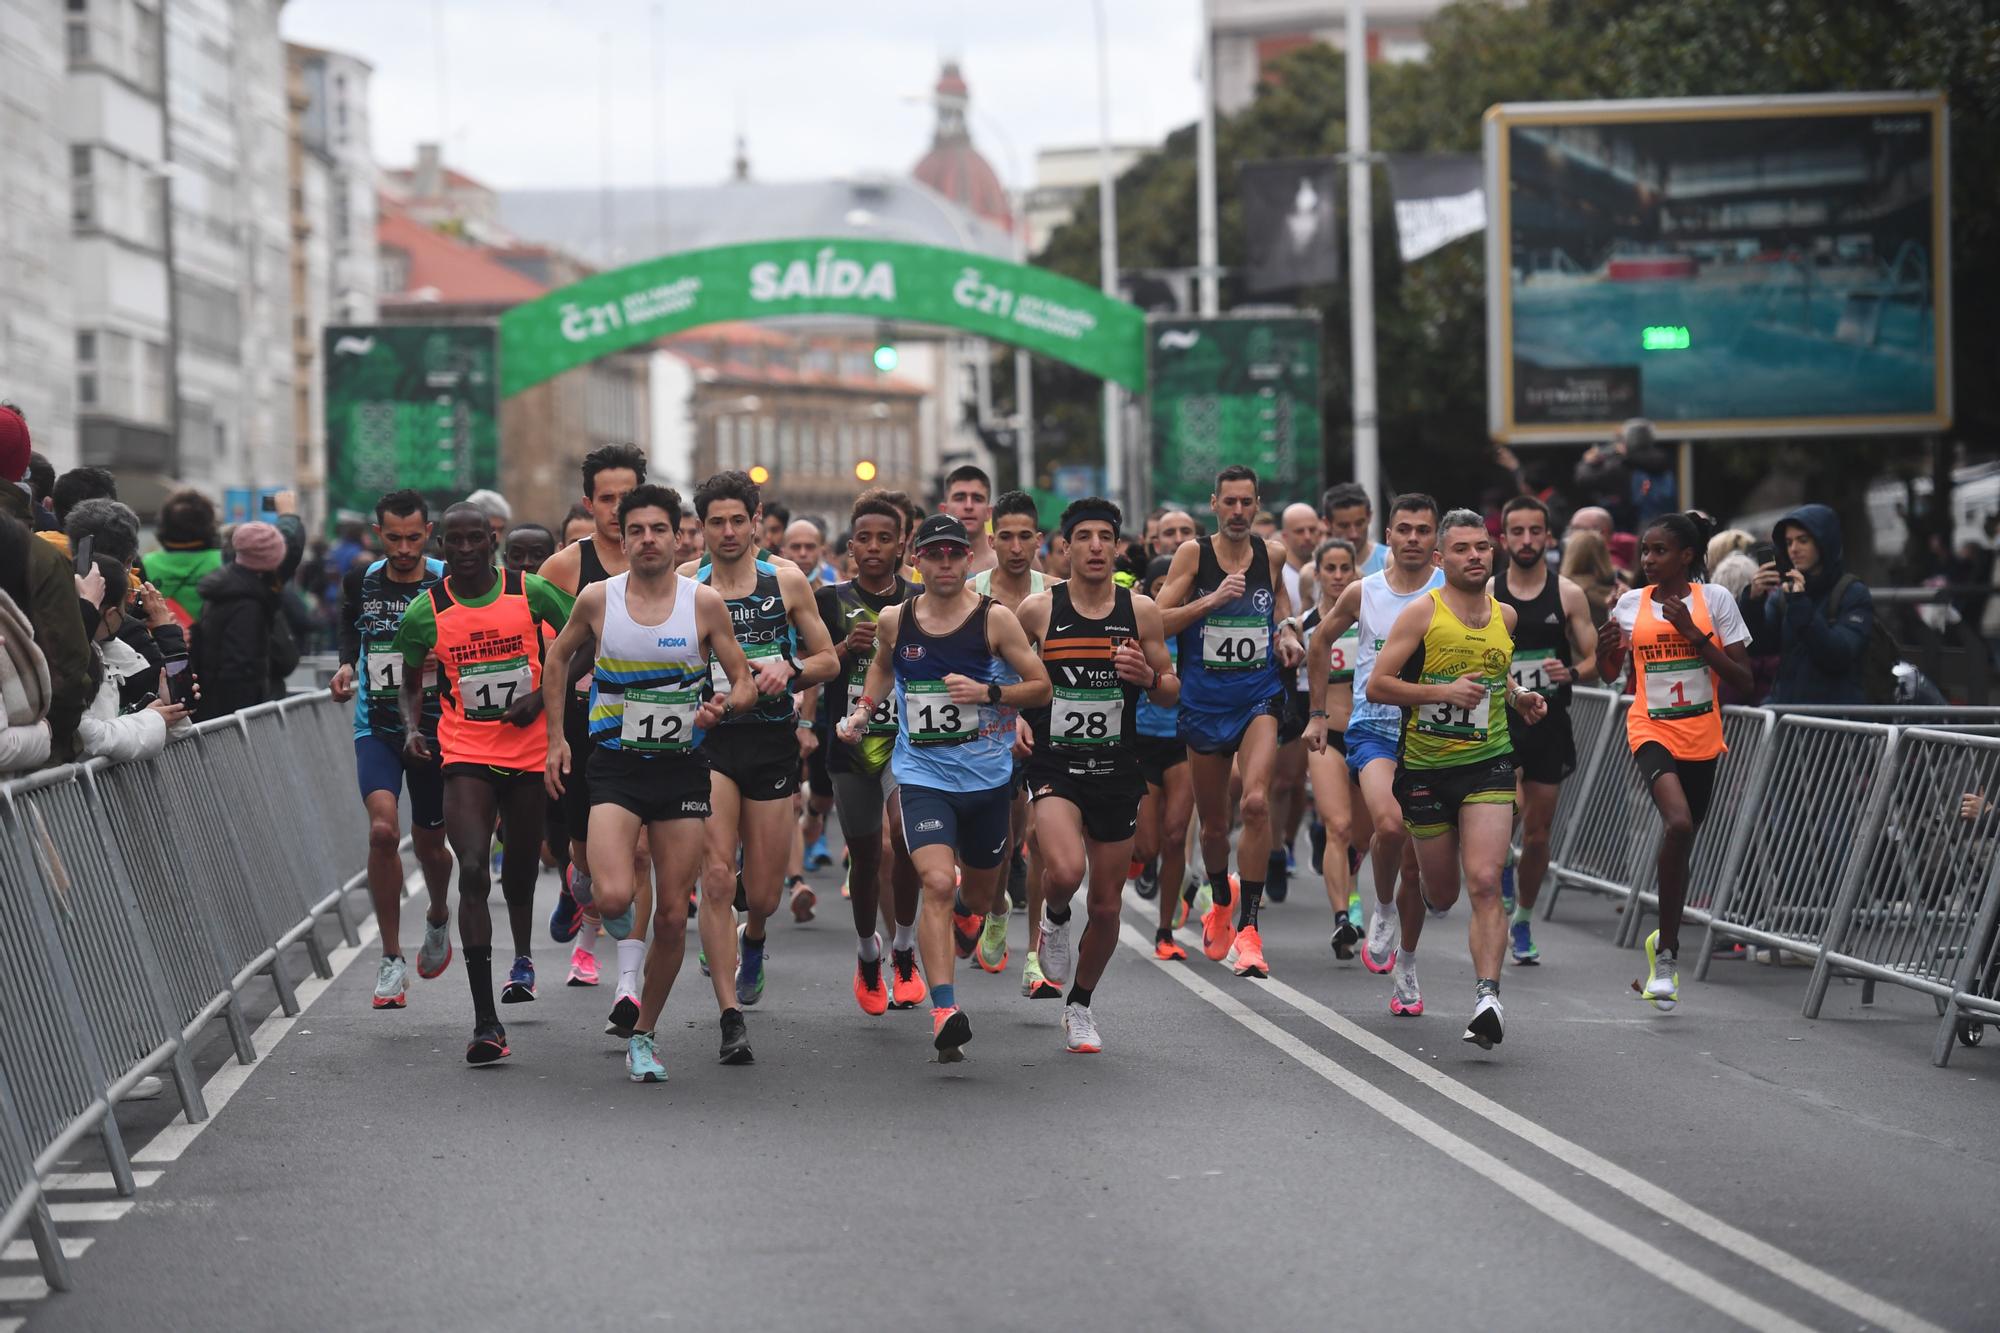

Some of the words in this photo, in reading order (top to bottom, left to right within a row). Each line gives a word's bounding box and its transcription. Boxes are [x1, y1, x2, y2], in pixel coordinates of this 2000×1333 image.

[748, 247, 897, 302] SAÍDA
[657, 638, 687, 647] HOKA
[1216, 637, 1256, 662] 40
[381, 663, 401, 688] 1
[476, 681, 517, 710] 17
[1670, 681, 1691, 707] 1
[637, 714, 682, 743] 12
[919, 705, 962, 733] 13
[1064, 712, 1108, 738] 28
[1431, 703, 1475, 728] 31
[681, 801, 708, 812] HOKA
